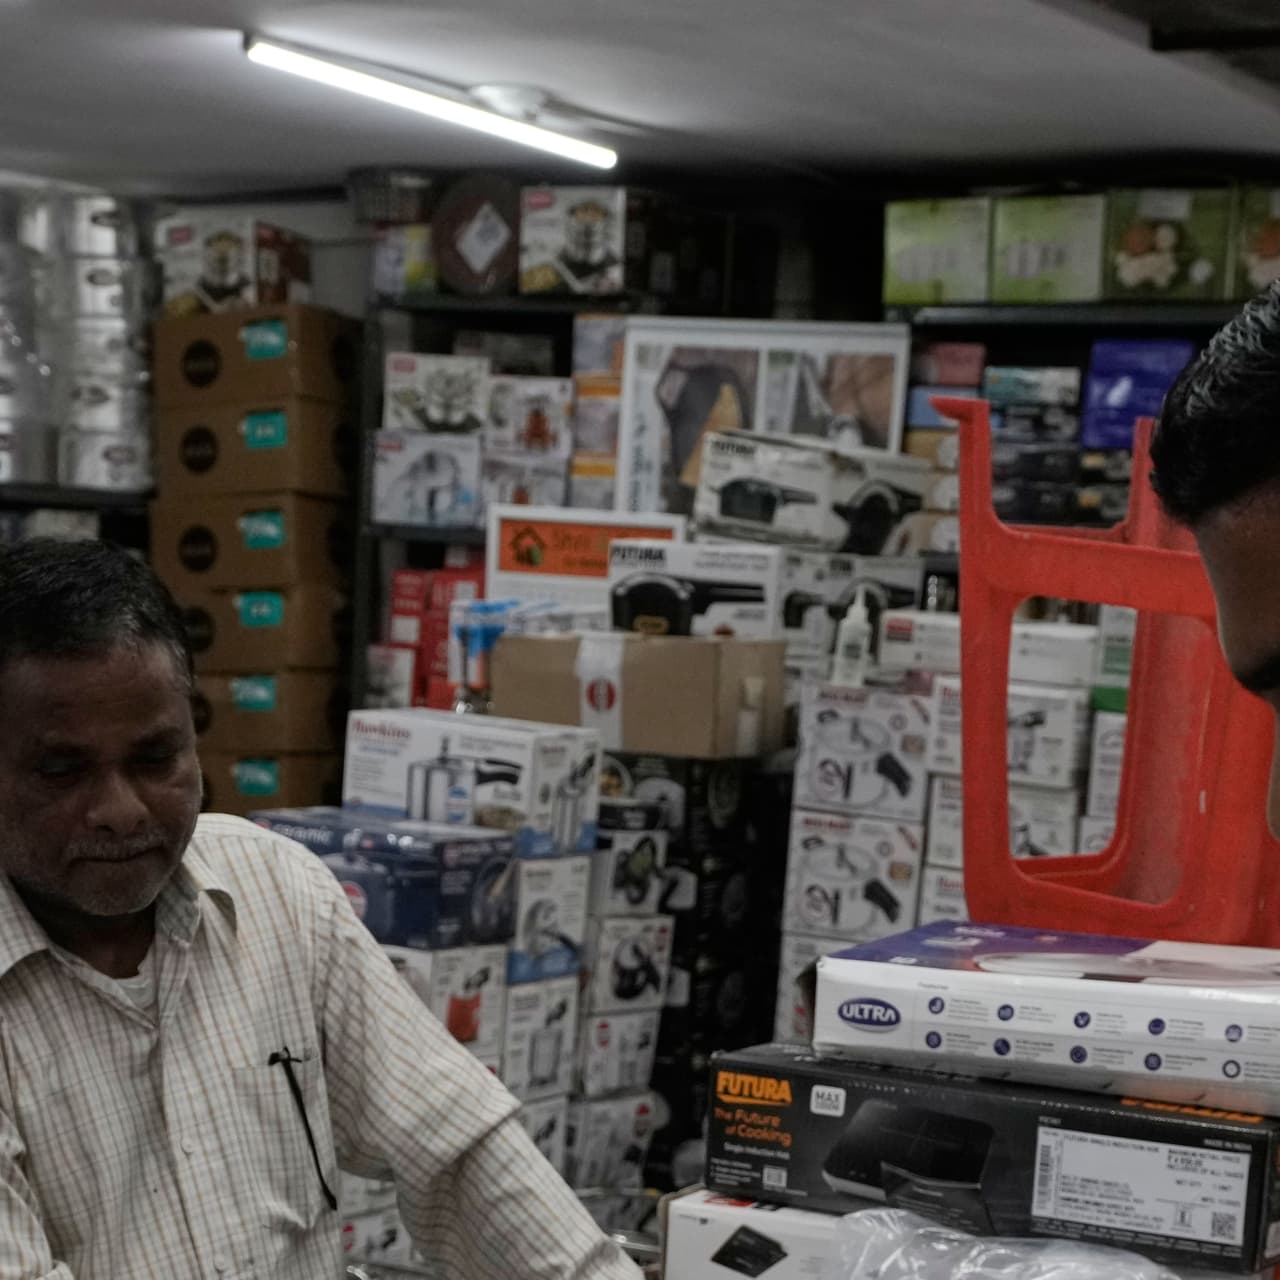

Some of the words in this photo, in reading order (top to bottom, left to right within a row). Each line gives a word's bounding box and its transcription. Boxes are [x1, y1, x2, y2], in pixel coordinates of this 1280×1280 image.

[842, 1002, 898, 1023] ULTRA
[716, 1071, 793, 1104] FUTURA
[734, 1108, 782, 1128] Future
[736, 1123, 793, 1148] Cooking
